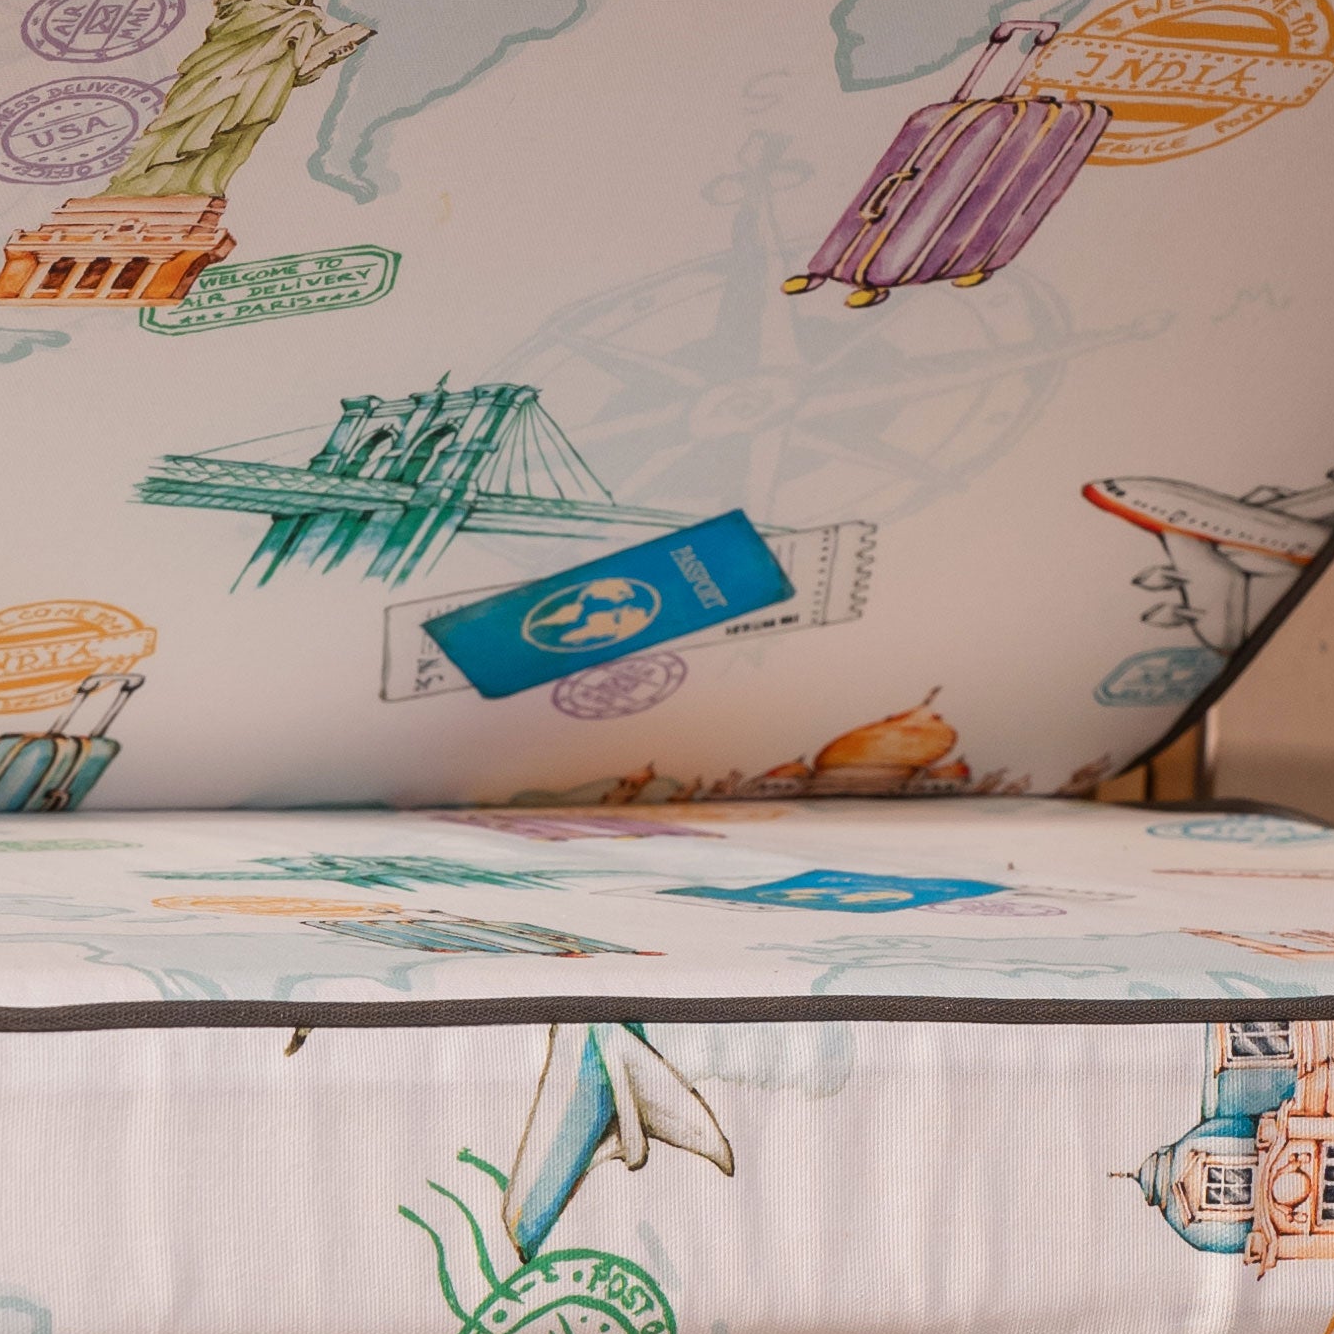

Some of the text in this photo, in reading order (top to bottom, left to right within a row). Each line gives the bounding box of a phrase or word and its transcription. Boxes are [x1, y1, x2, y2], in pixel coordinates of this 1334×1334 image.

[51, 4, 88, 37] AIR
[1074, 50, 1259, 93] INDIA
[47, 80, 139, 100] DELIVERY
[27, 115, 117, 149] USA
[177, 267, 372, 310] AIR DELIVERY
[198, 257, 344, 291] WELCOME TO
[234, 294, 314, 318] PARIS
[670, 544, 729, 610] PASSPORT
[587, 1261, 655, 1317] POST
